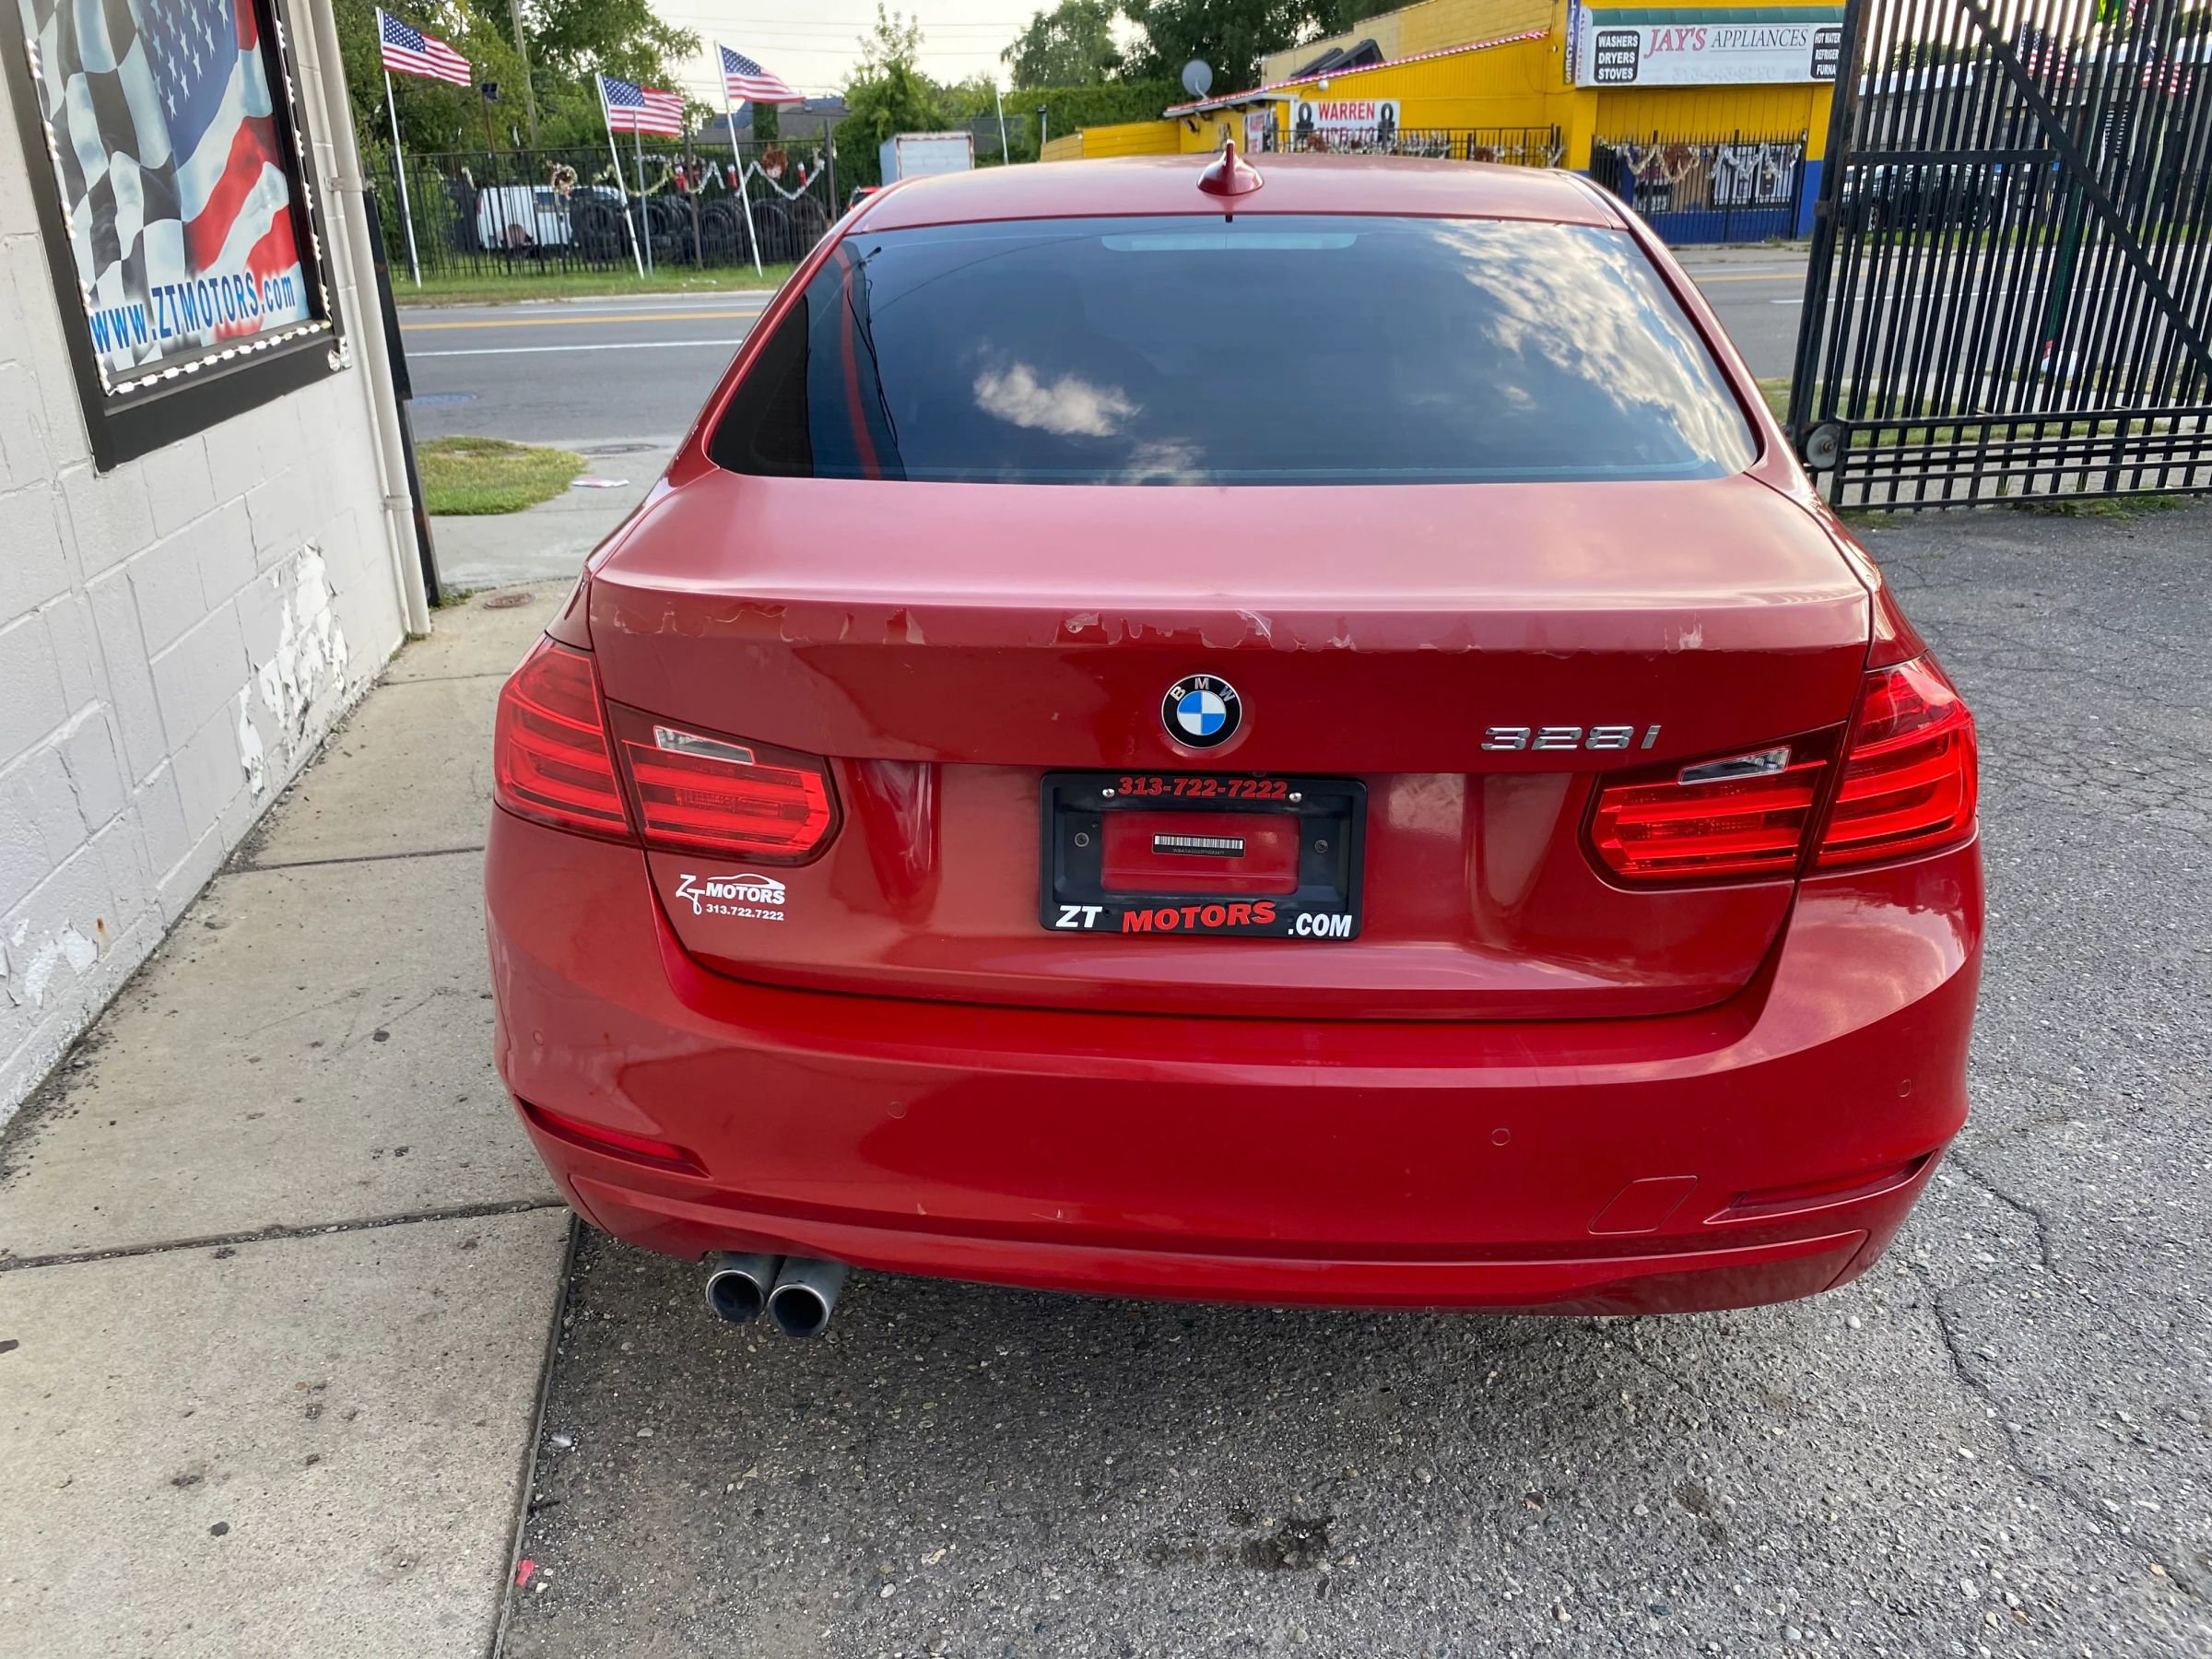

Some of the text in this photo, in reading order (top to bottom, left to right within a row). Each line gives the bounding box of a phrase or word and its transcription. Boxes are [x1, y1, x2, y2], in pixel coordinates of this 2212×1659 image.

[1597, 35, 1639, 48] WASHERS
[1643, 28, 1809, 59] JAY'S APPLIANCES
[1815, 32, 1825, 44] HOT
[1597, 52, 1636, 65] DRYERS
[1597, 67, 1634, 80] STOVES
[1318, 102, 1375, 121] WARREN
[1170, 677, 1236, 702] BMW
[1480, 724, 1662, 751] 328i
[1118, 777, 1288, 800] 313-722-7222
[705, 882, 785, 905] MOTORS
[706, 903, 784, 922] 313.722.7222
[1055, 901, 1353, 937] ZT MOTORS .COM
